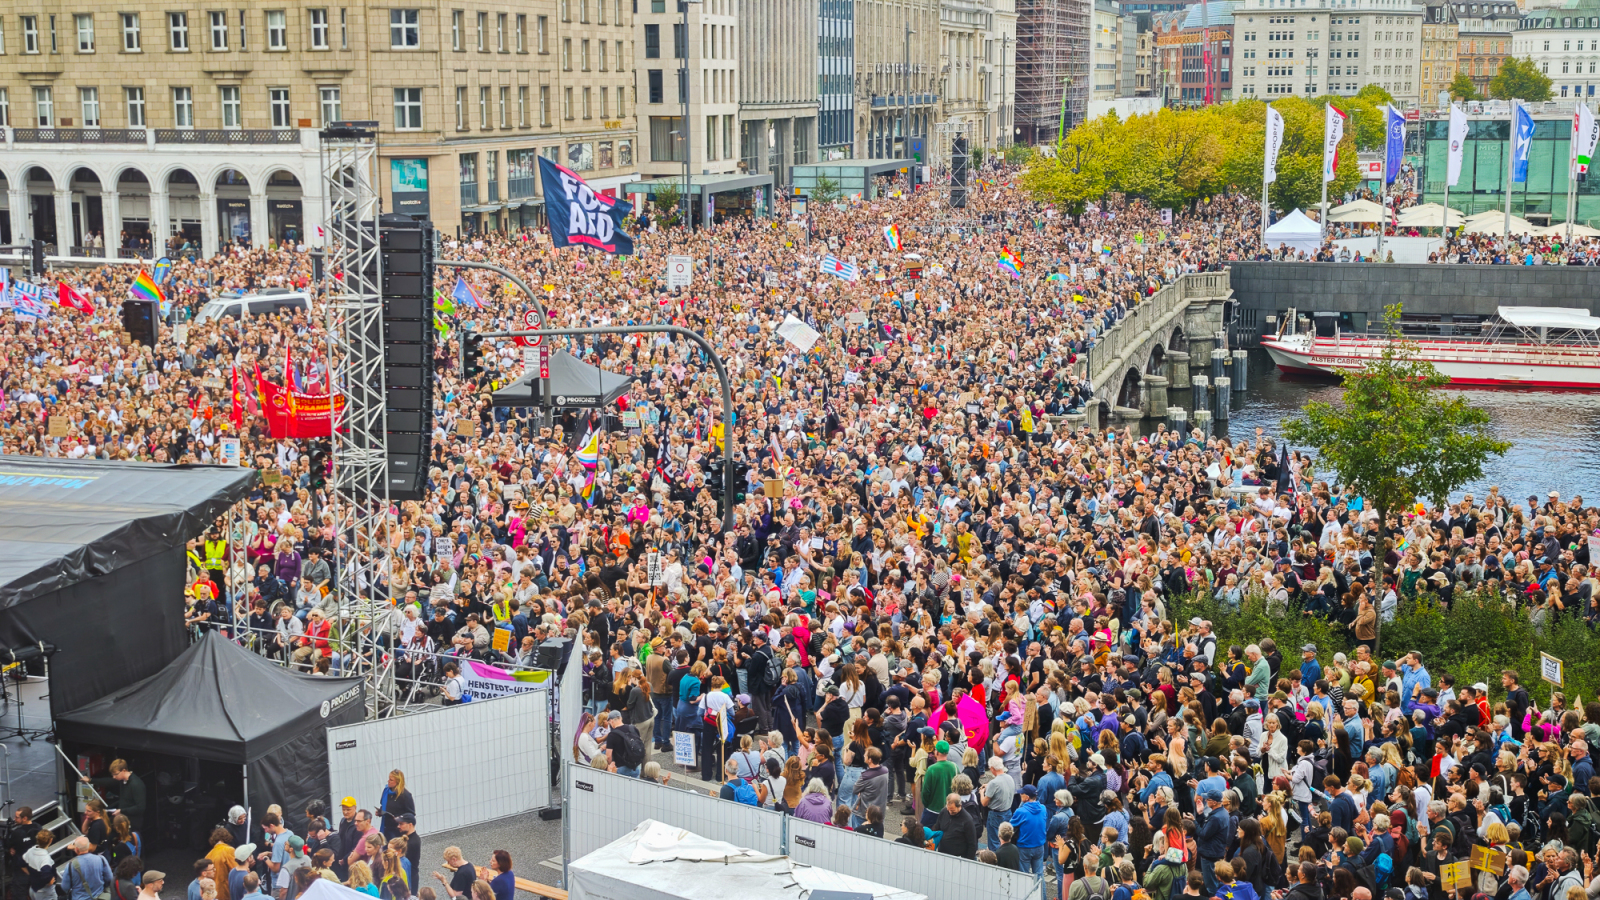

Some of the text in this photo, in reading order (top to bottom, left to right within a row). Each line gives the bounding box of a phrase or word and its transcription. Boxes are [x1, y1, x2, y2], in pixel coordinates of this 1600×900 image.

[913, 141, 922, 151] U
[913, 152, 921, 162] S
[528, 314, 539, 323] 30
[1337, 357, 1362, 365] CABRIO
[331, 684, 360, 709] PROTONES
